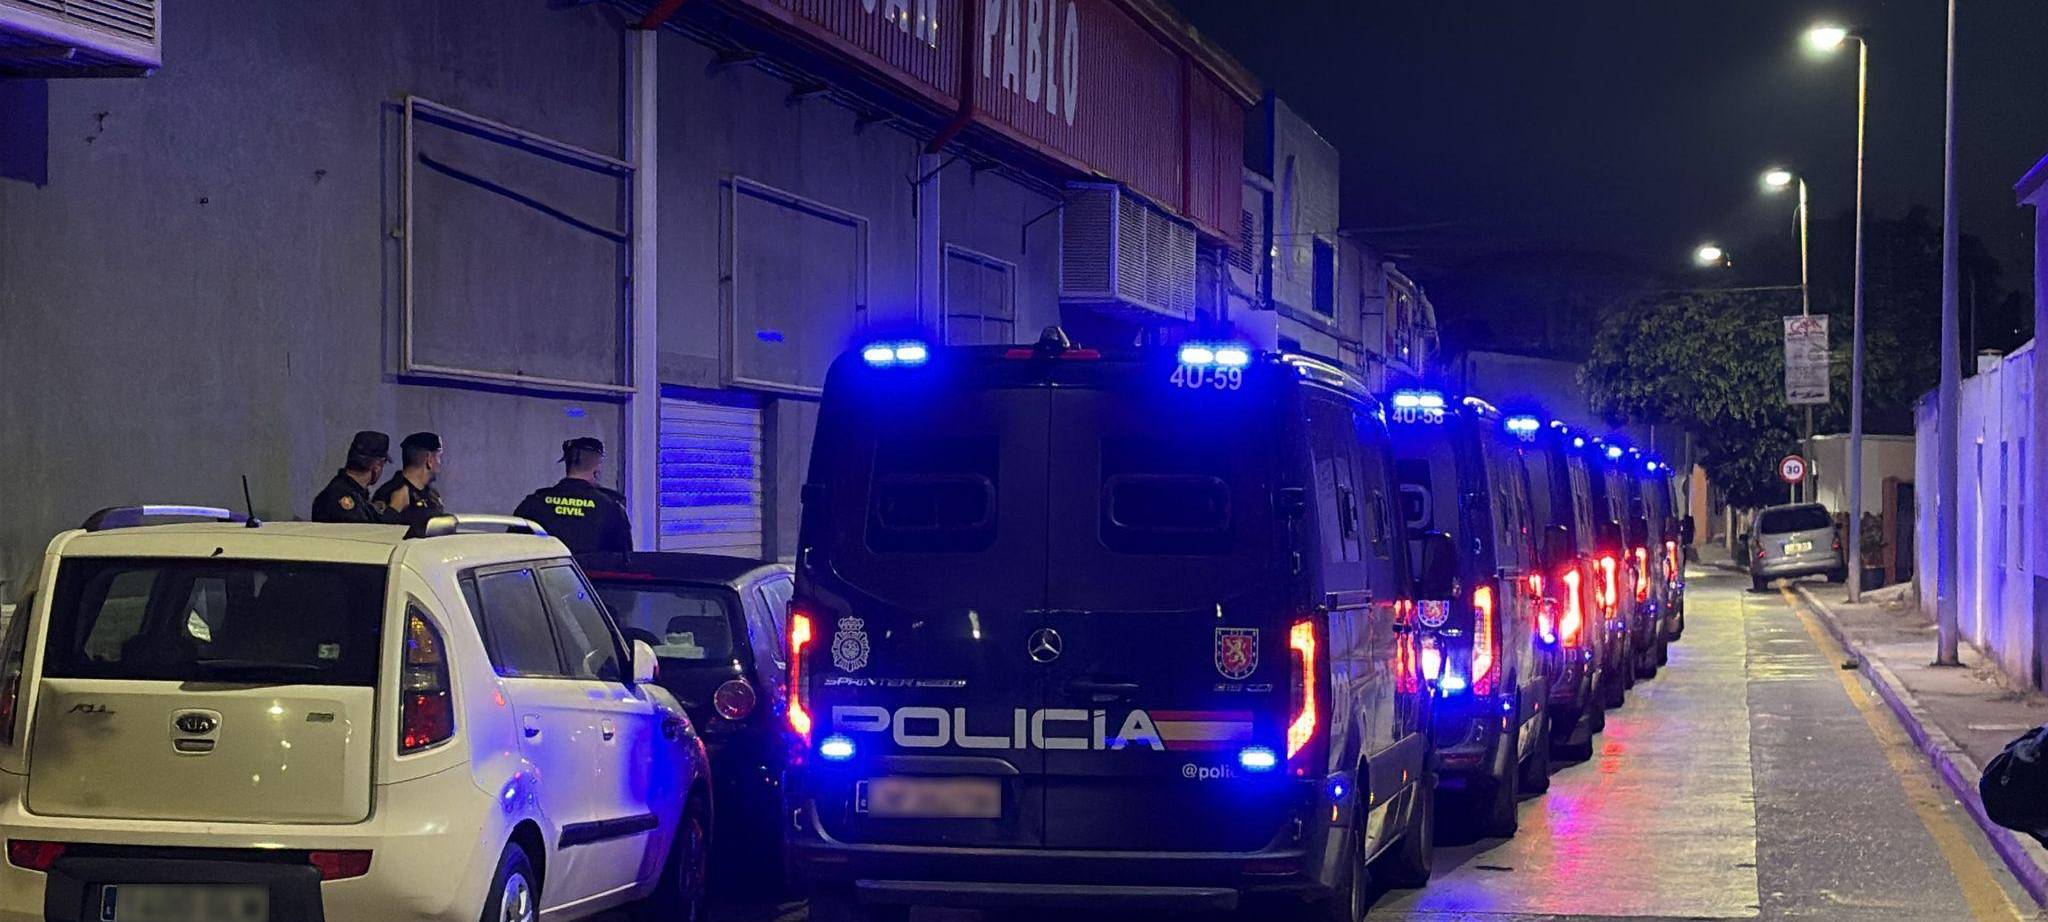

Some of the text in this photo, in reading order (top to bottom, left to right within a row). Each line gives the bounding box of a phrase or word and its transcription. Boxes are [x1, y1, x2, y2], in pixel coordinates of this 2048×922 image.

[983, 0, 1079, 126] PABLO
[1170, 364, 1242, 390] 4U-59
[1786, 465, 1800, 475] 30
[545, 496, 595, 508] GUARDIA
[555, 506, 585, 516] CIVIL
